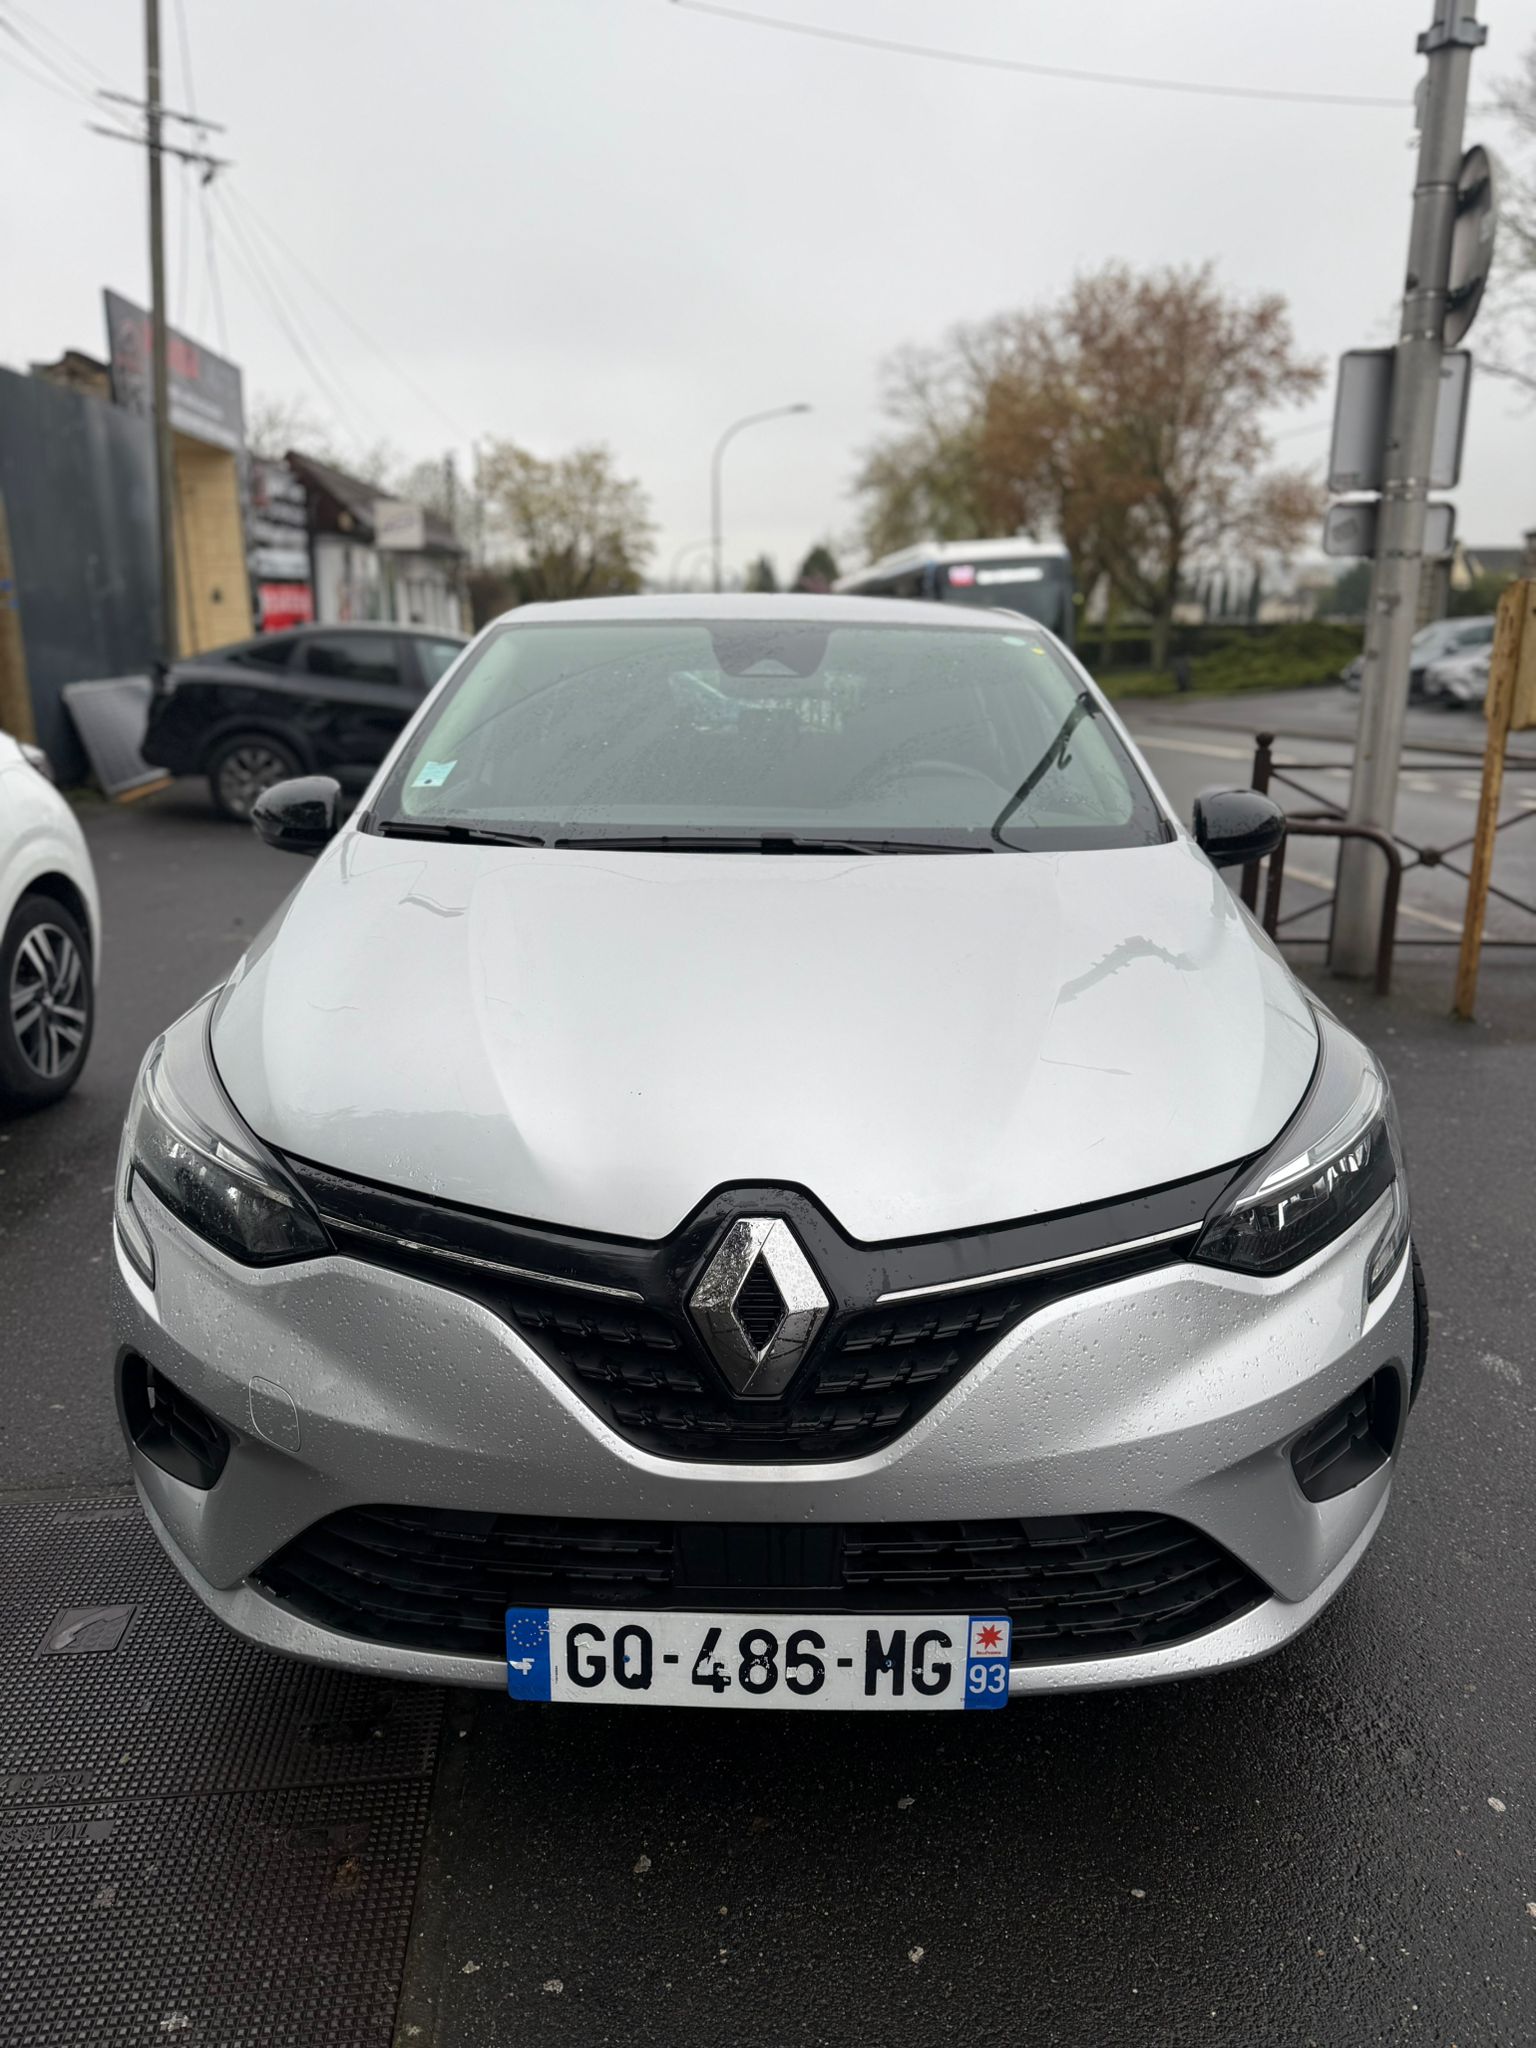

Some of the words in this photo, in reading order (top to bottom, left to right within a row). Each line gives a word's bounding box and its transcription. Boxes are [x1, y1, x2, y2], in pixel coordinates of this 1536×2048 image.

[566, 1622, 953, 1696] GQ-486-MG
[969, 1664, 1006, 1694] 93
[0, 1823, 89, 1843] SSEVAL
